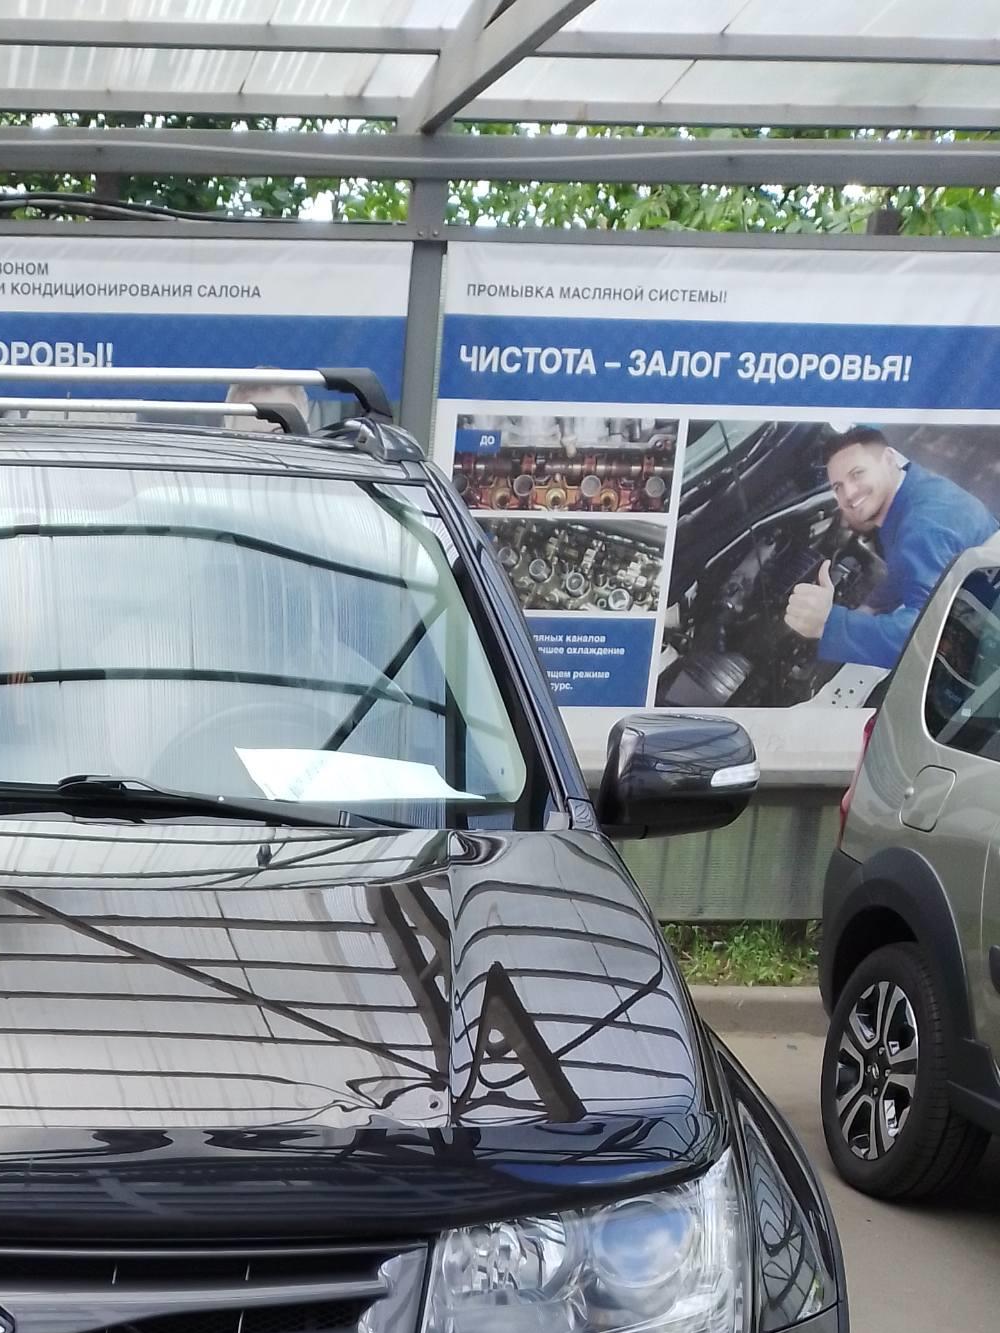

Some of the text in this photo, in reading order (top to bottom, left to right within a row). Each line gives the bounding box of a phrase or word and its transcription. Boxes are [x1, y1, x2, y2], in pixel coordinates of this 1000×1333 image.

[10, 281, 192, 299] КОНДИЦИОНИРОВАНИЯ
[197, 283, 261, 298] САЛОНА
[467, 284, 727, 303] ПРОМЫВКА МАСЛЯНОЙ СИСТЕМЫ!
[460, 344, 597, 374] ЧИСТОТА
[628, 349, 730, 378] ЗАЛОГ
[737, 352, 912, 384] ЗДОРОВЬЯ!
[480, 435, 495, 447] ДО
[566, 635, 606, 643] каналов
[566, 647, 625, 656] охлаждение
[572, 671, 610, 680] режиме
